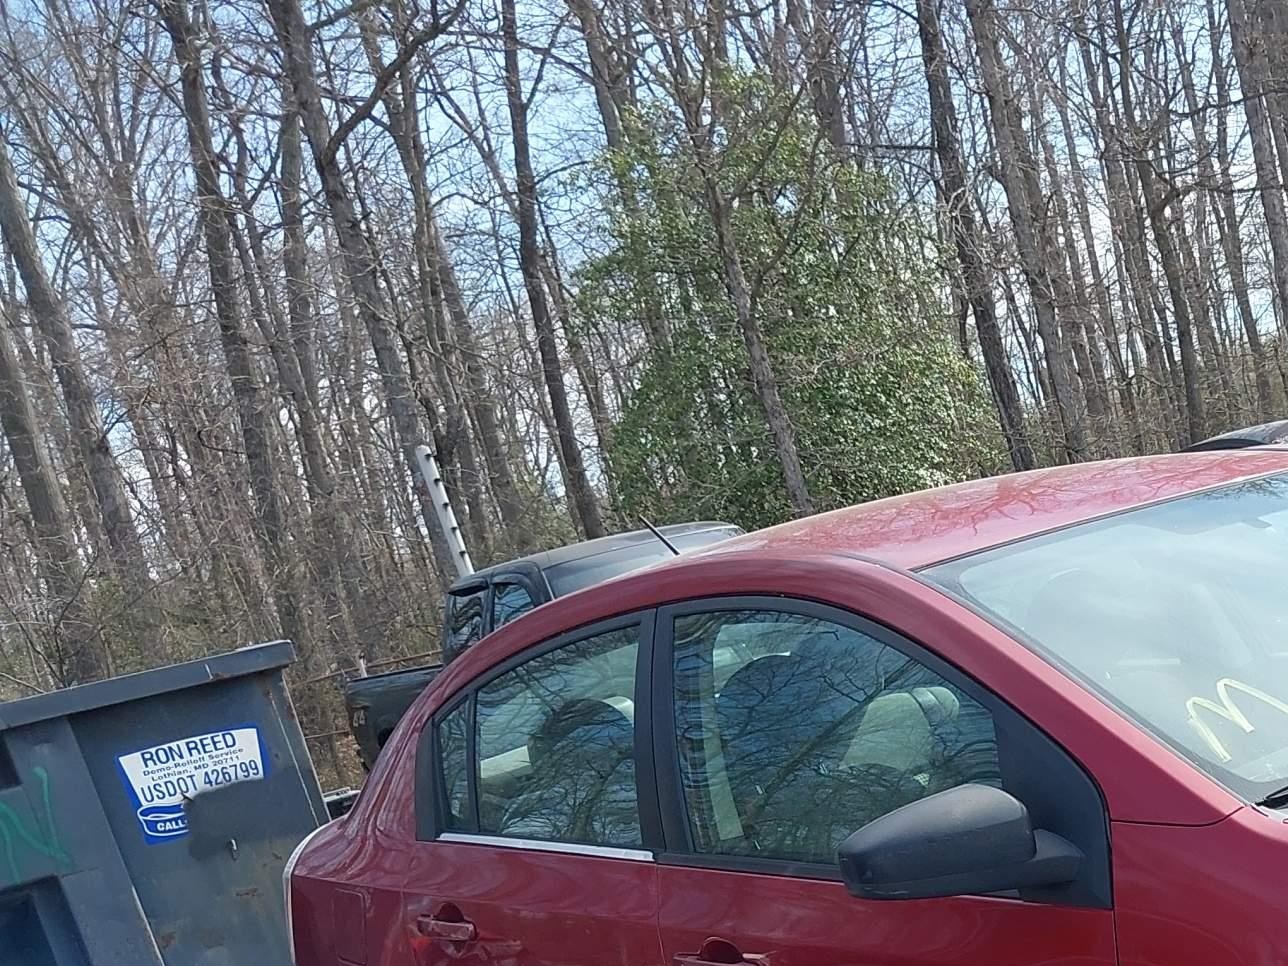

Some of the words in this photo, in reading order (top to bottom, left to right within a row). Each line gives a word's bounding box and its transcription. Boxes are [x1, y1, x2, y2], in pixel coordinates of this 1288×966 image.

[140, 743, 184, 768] RON
[185, 732, 236, 757] REED
[143, 757, 206, 777] Demo-Rolloff
[208, 748, 244, 760] Service
[140, 774, 198, 803] USDOT
[203, 759, 260, 787] 426799
[151, 769, 192, 782] Lothian,
[194, 763, 209, 771] MD
[212, 755, 240, 767] 20711
